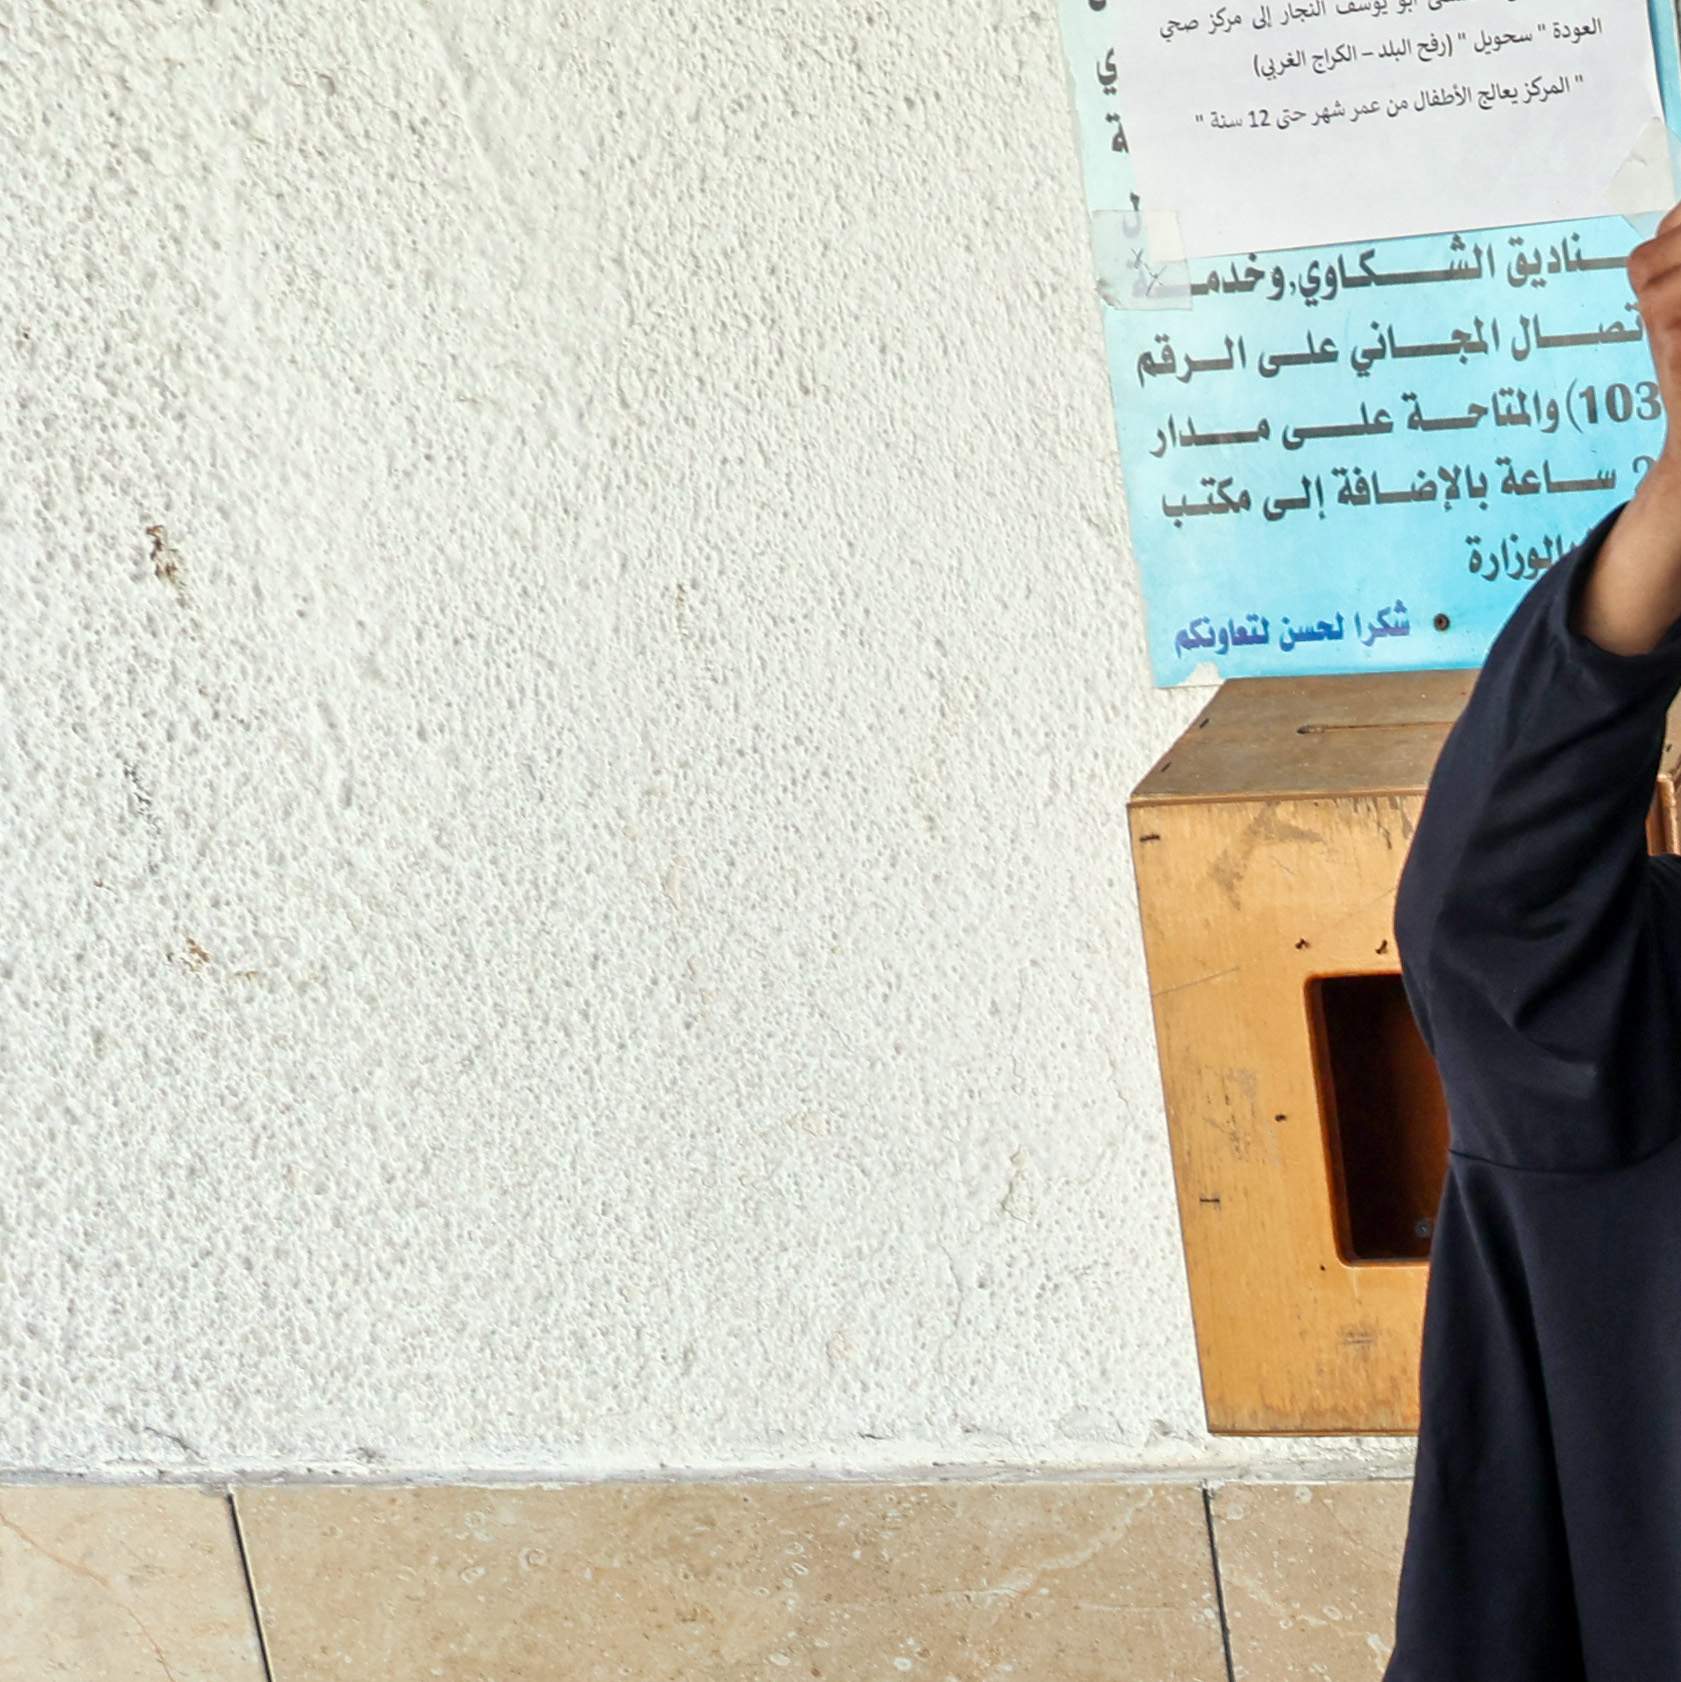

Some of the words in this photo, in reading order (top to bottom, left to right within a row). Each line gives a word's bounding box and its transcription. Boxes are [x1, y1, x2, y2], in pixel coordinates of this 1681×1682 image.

[1207, 6, 1243, 35] مركز
[1251, 4, 1272, 31] إلى
[1280, 0, 1327, 26] النجار
[1159, 17, 1199, 43] صحي
[1551, 17, 1603, 45] العودة
[1311, 43, 1357, 74] الكراج
[1377, 38, 1412, 63] البلد
[1414, 85, 1473, 112] الأطفال
[1477, 83, 1519, 110] يعالج
[1523, 76, 1571, 104] المركز
[1210, 111, 1244, 130] سنة
[1248, 108, 1271, 129] 12
[1276, 109, 1308, 130] حتى
[1310, 98, 1347, 126] شهر
[1349, 102, 1382, 123] عمر
[1385, 99, 1409, 118] من
[1507, 231, 1629, 289] ناديق
[1257, 329, 1339, 379] على
[1350, 314, 1500, 378] المجاني
[1136, 333, 1247, 389] الرقم
[1148, 413, 1271, 459] مدار
[1281, 401, 1394, 451] على
[1330, 463, 1489, 512] بالإضافة
[1494, 456, 1617, 497] ساعة
[1161, 476, 1252, 529] مكتب
[1262, 473, 1325, 522] إلى
[1278, 610, 1345, 653] لحسن
[1353, 599, 1411, 648] شكرا
